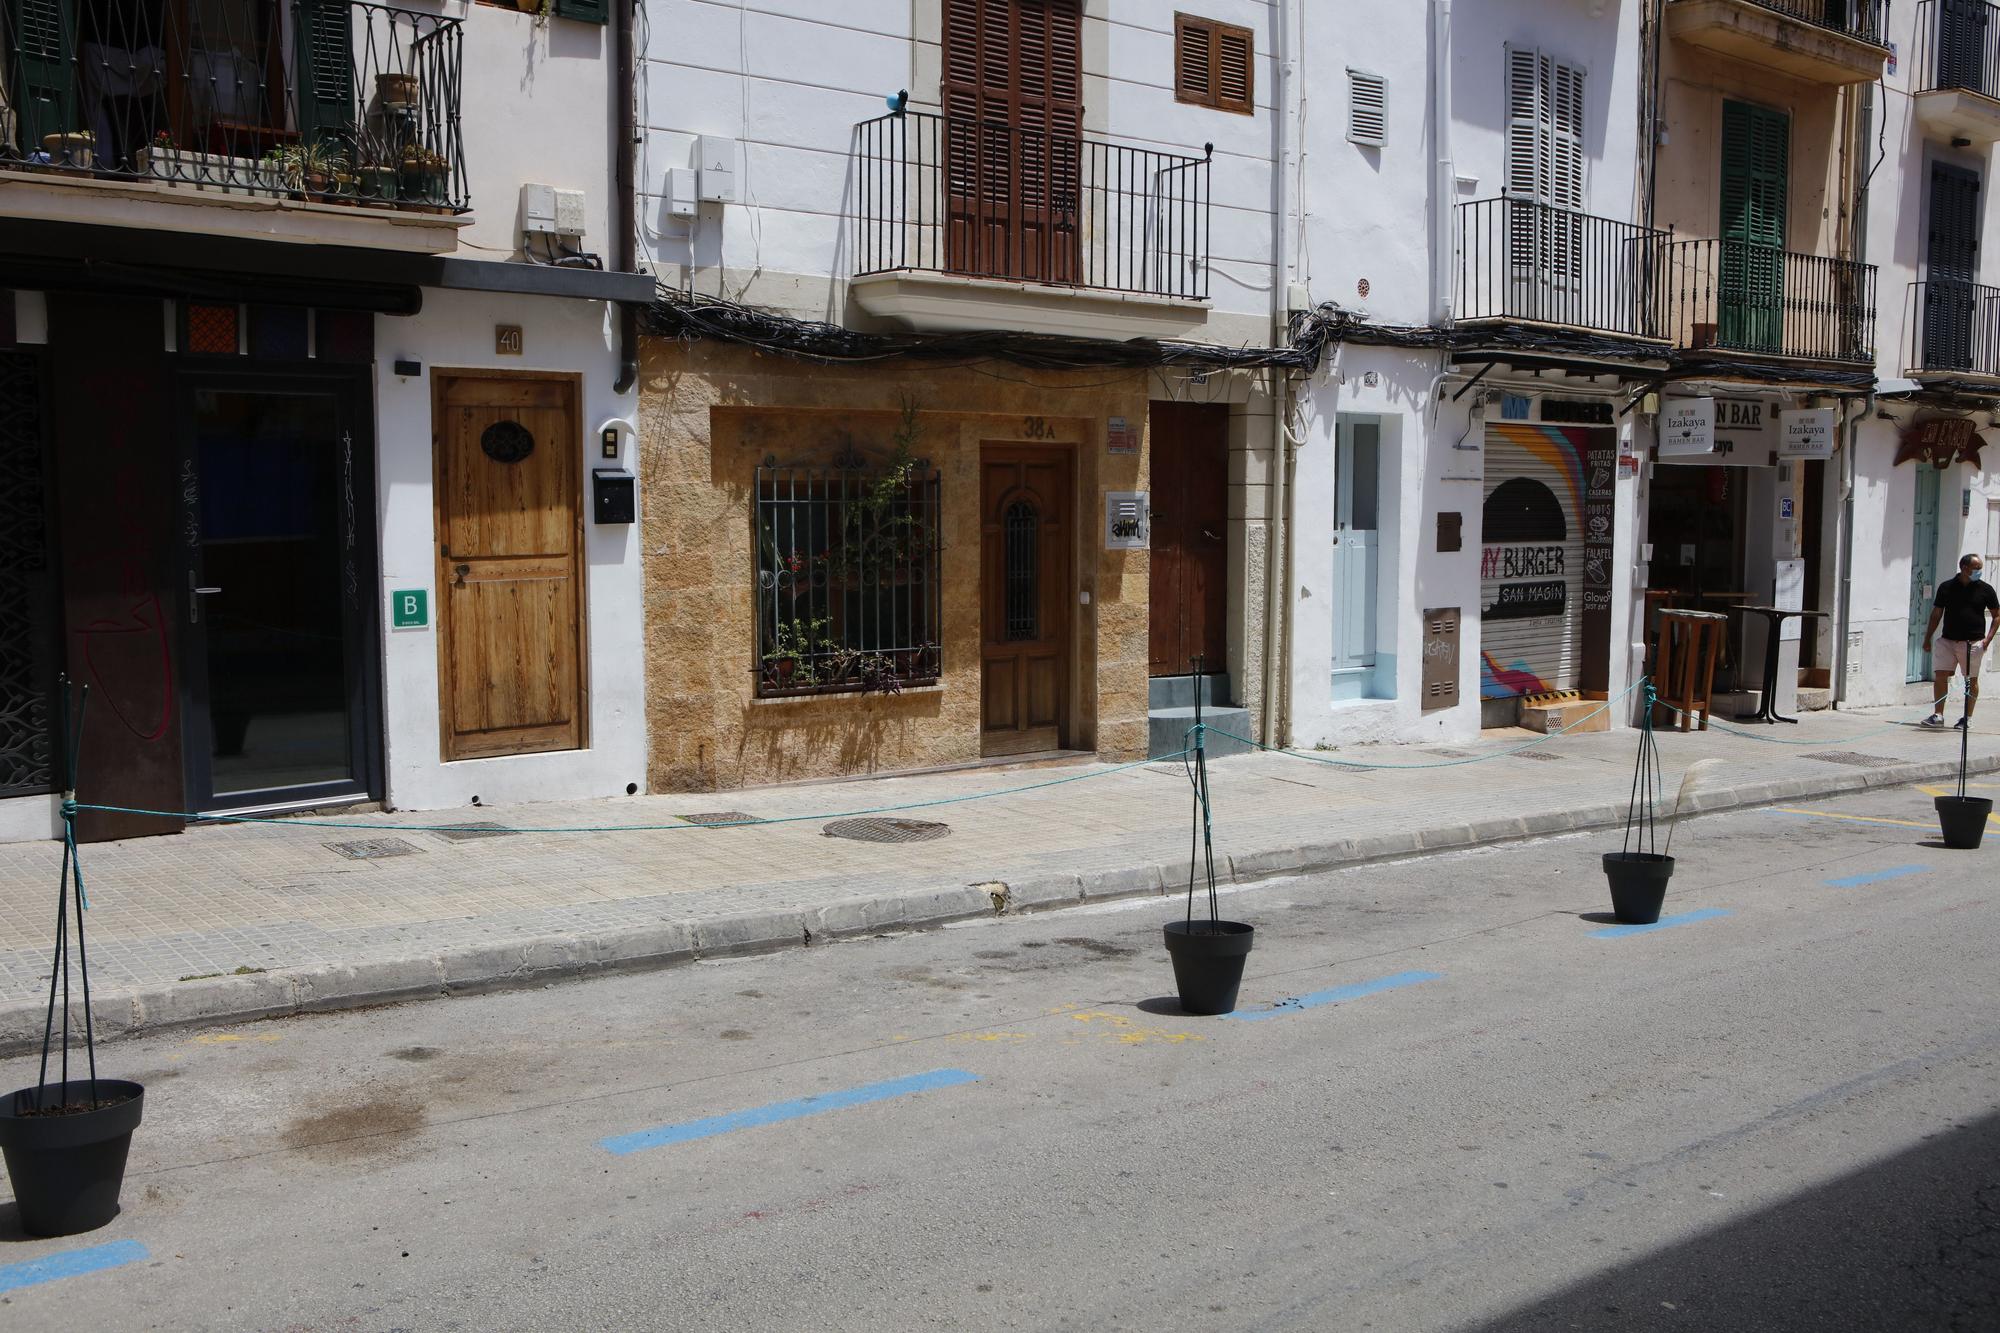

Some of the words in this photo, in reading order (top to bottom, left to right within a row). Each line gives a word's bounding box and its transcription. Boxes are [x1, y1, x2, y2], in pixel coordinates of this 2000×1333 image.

[500, 329, 520, 352] 40
[1501, 396, 1532, 419] MY
[1731, 403, 1761, 425] BAR
[1023, 416, 1056, 439] 38A
[1668, 415, 1706, 430] Izakaya
[1788, 424, 1825, 437] Izakaya
[1587, 450, 1615, 460] PATATAS
[1504, 546, 1565, 578] BURGER
[1586, 547, 1612, 560] FALAFEL
[1503, 587, 1523, 603] SAN
[1584, 591, 1611, 603] Glovo
[405, 595, 418, 615] B
